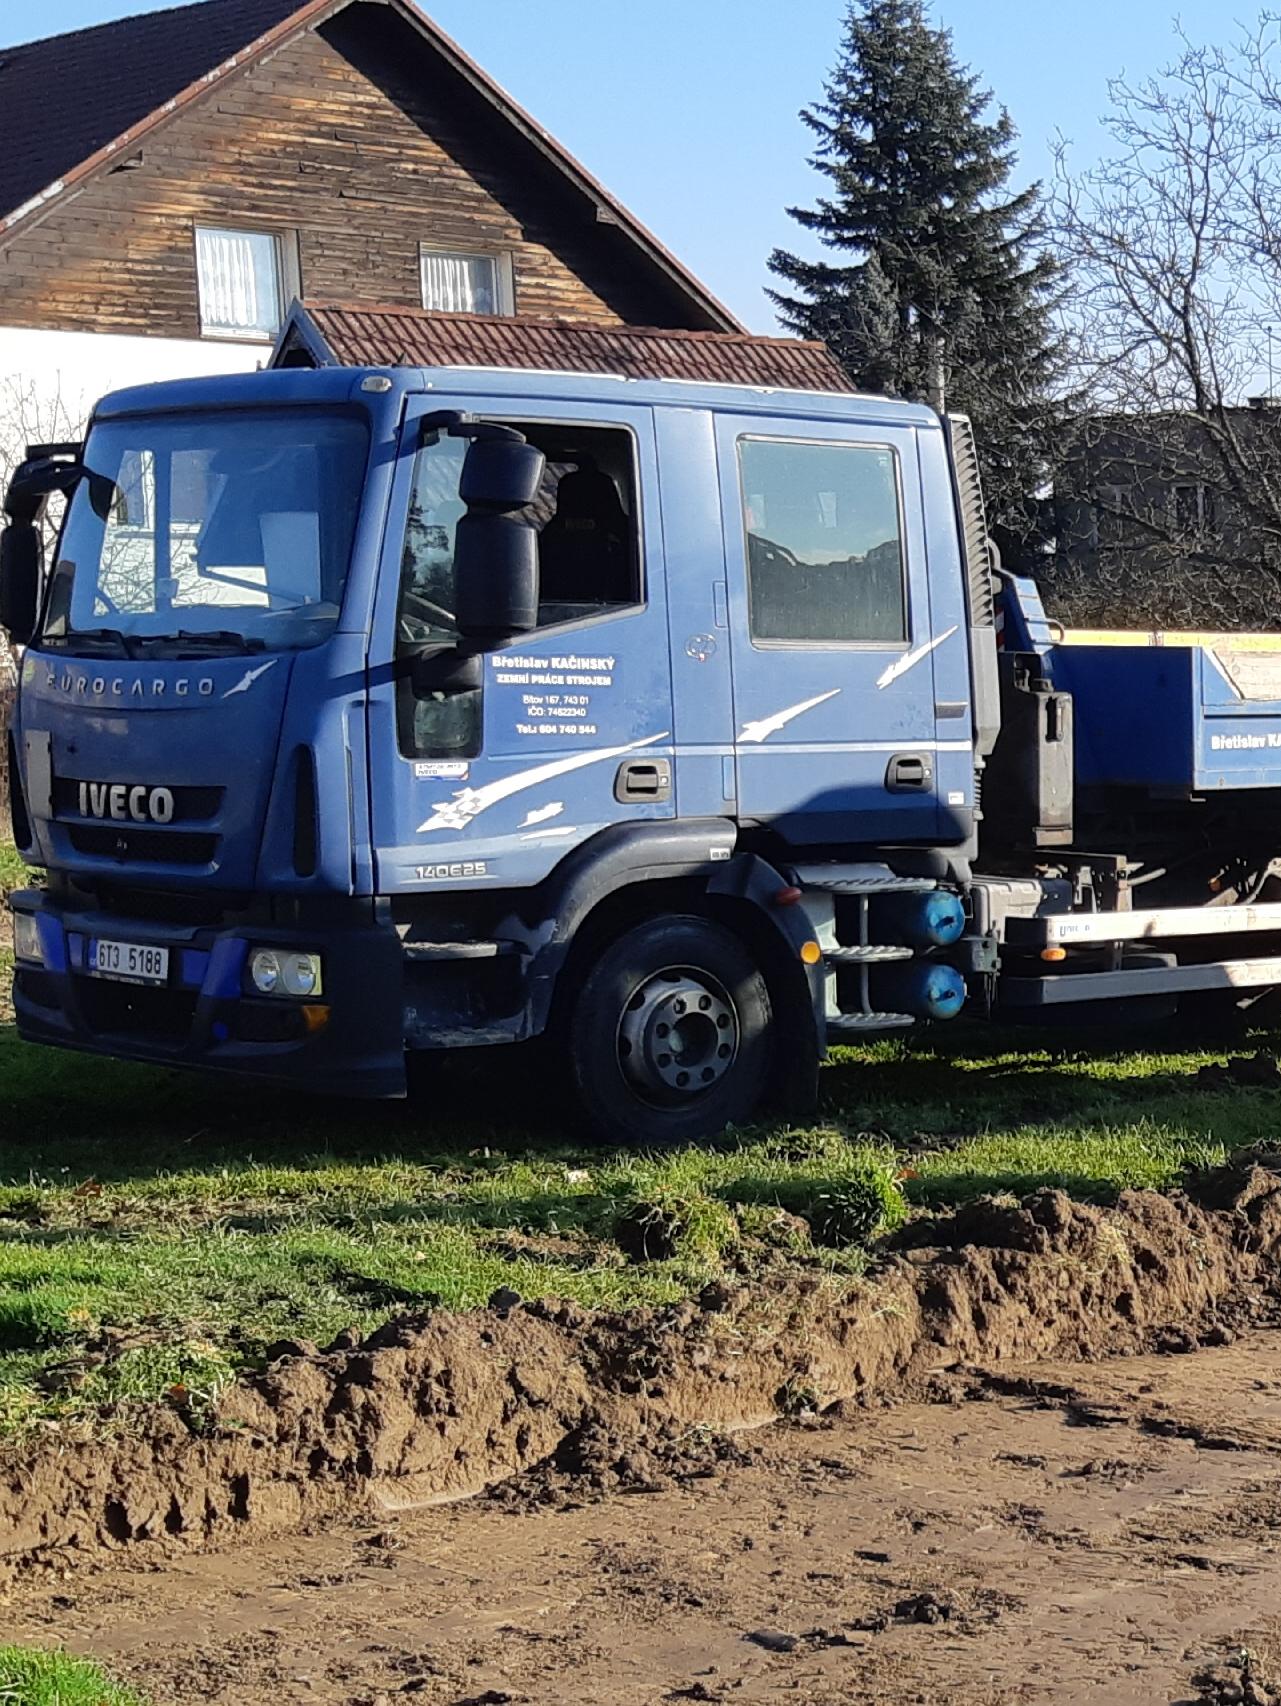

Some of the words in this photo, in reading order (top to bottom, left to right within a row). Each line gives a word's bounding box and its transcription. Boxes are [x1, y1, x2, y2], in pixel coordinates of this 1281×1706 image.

[551, 654, 615, 671] KAČINSKÝ
[47, 674, 213, 695] EUROCARGO
[566, 675, 612, 686] STROJEM
[579, 696, 589, 705] 01
[1211, 734, 1266, 750] Břetislav
[79, 782, 174, 823] IVECO
[99, 944, 120, 969] 6T3
[129, 947, 162, 975] 5188
